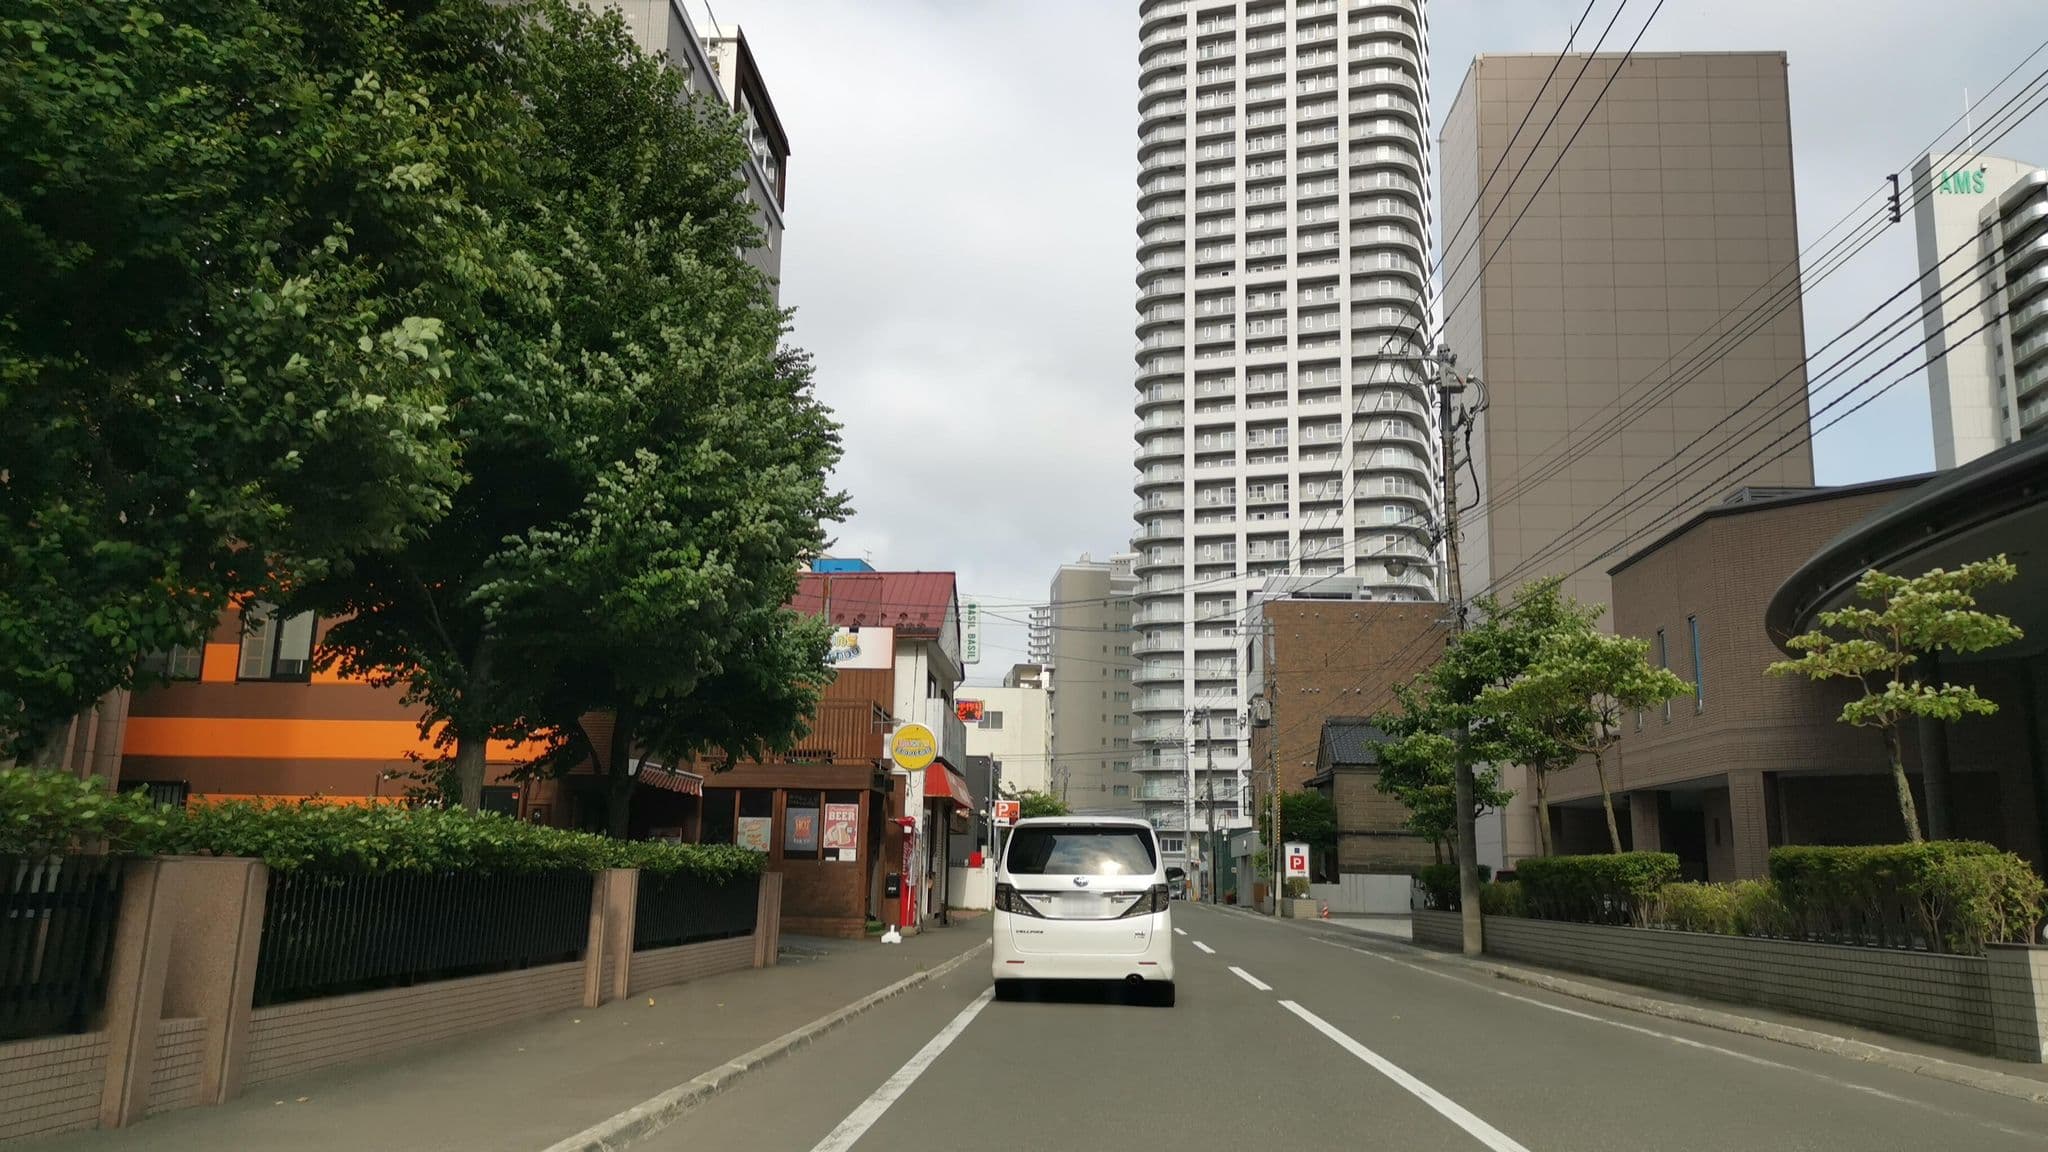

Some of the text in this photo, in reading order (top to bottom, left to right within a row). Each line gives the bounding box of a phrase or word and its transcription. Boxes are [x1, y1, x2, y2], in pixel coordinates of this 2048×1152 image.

[1939, 169, 1985, 194] AMS
[967, 603, 976, 659] BASIL BASIL
[828, 811, 856, 821] BEER
[998, 803, 1009, 816] P
[1293, 858, 1302, 869] P
